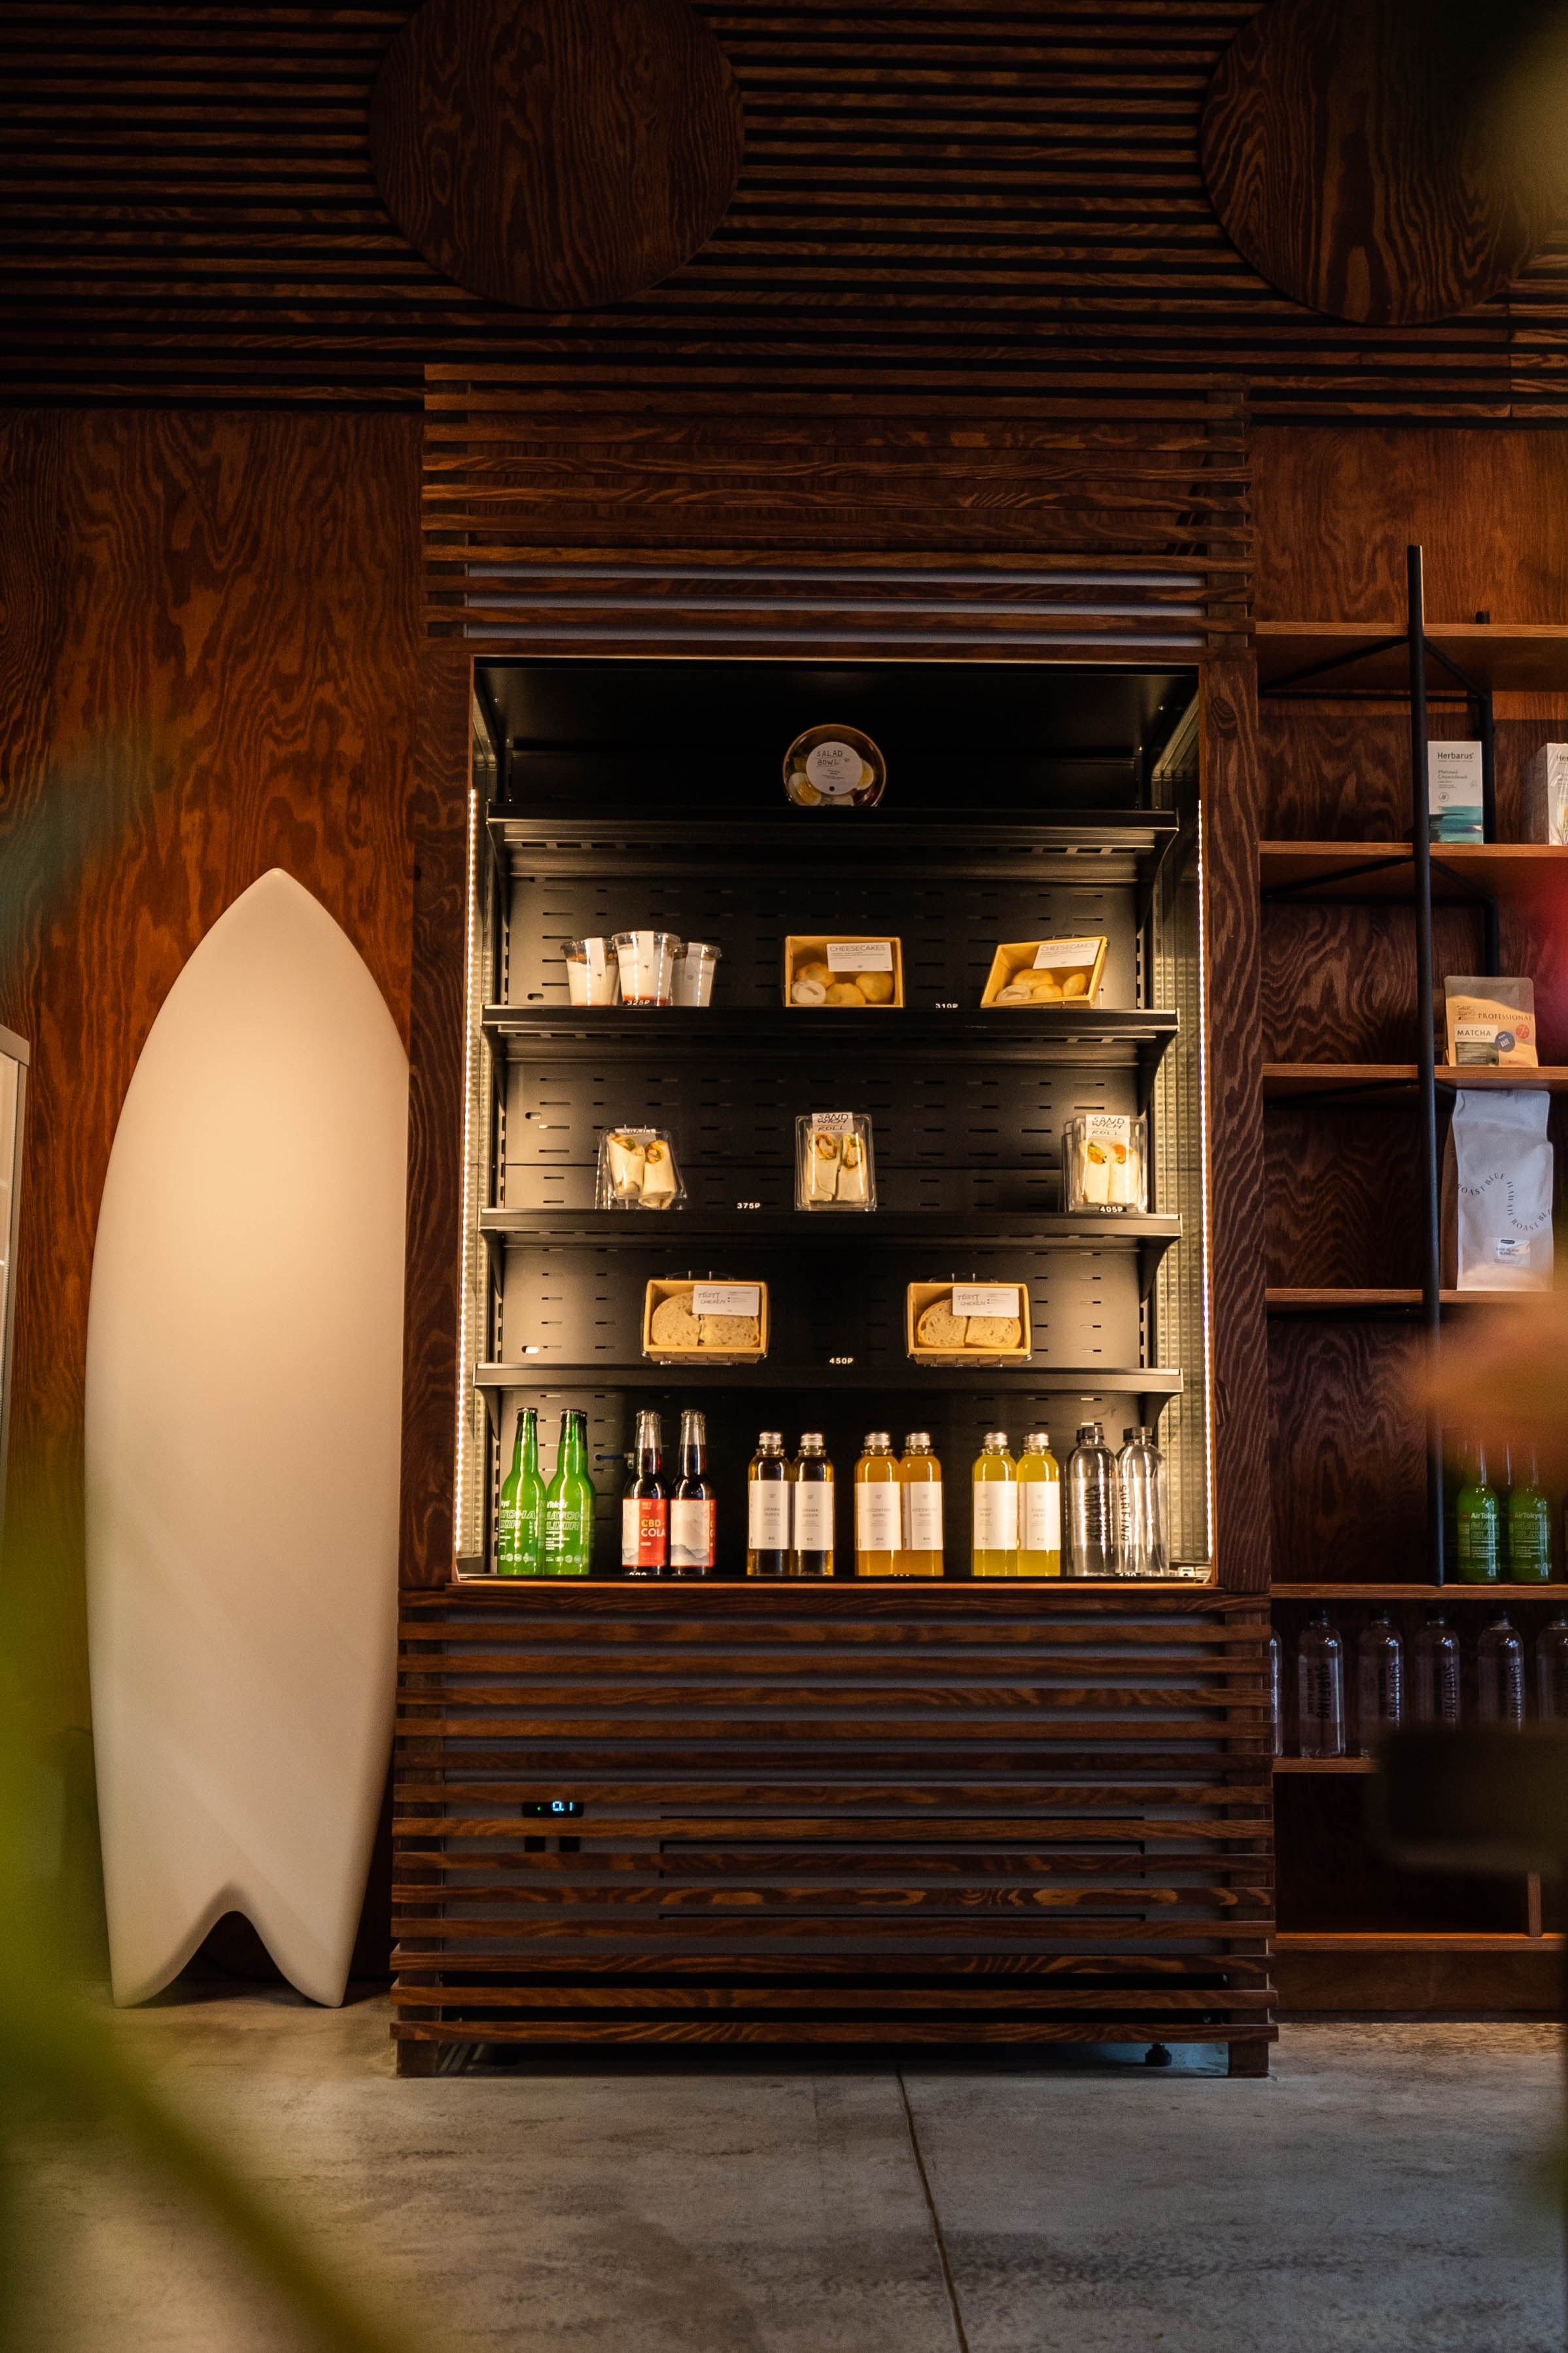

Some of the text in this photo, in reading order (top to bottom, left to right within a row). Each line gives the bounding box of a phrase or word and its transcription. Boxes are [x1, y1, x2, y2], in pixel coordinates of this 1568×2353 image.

[1041, 942, 1094, 952] CHEESECAKES
[1478, 1013, 1532, 1021] PROFESSIONAL
[641, 1519, 661, 1527] CBD
[641, 1528, 666, 1537] COLA
[1315, 1664, 1329, 1720] SURFING
